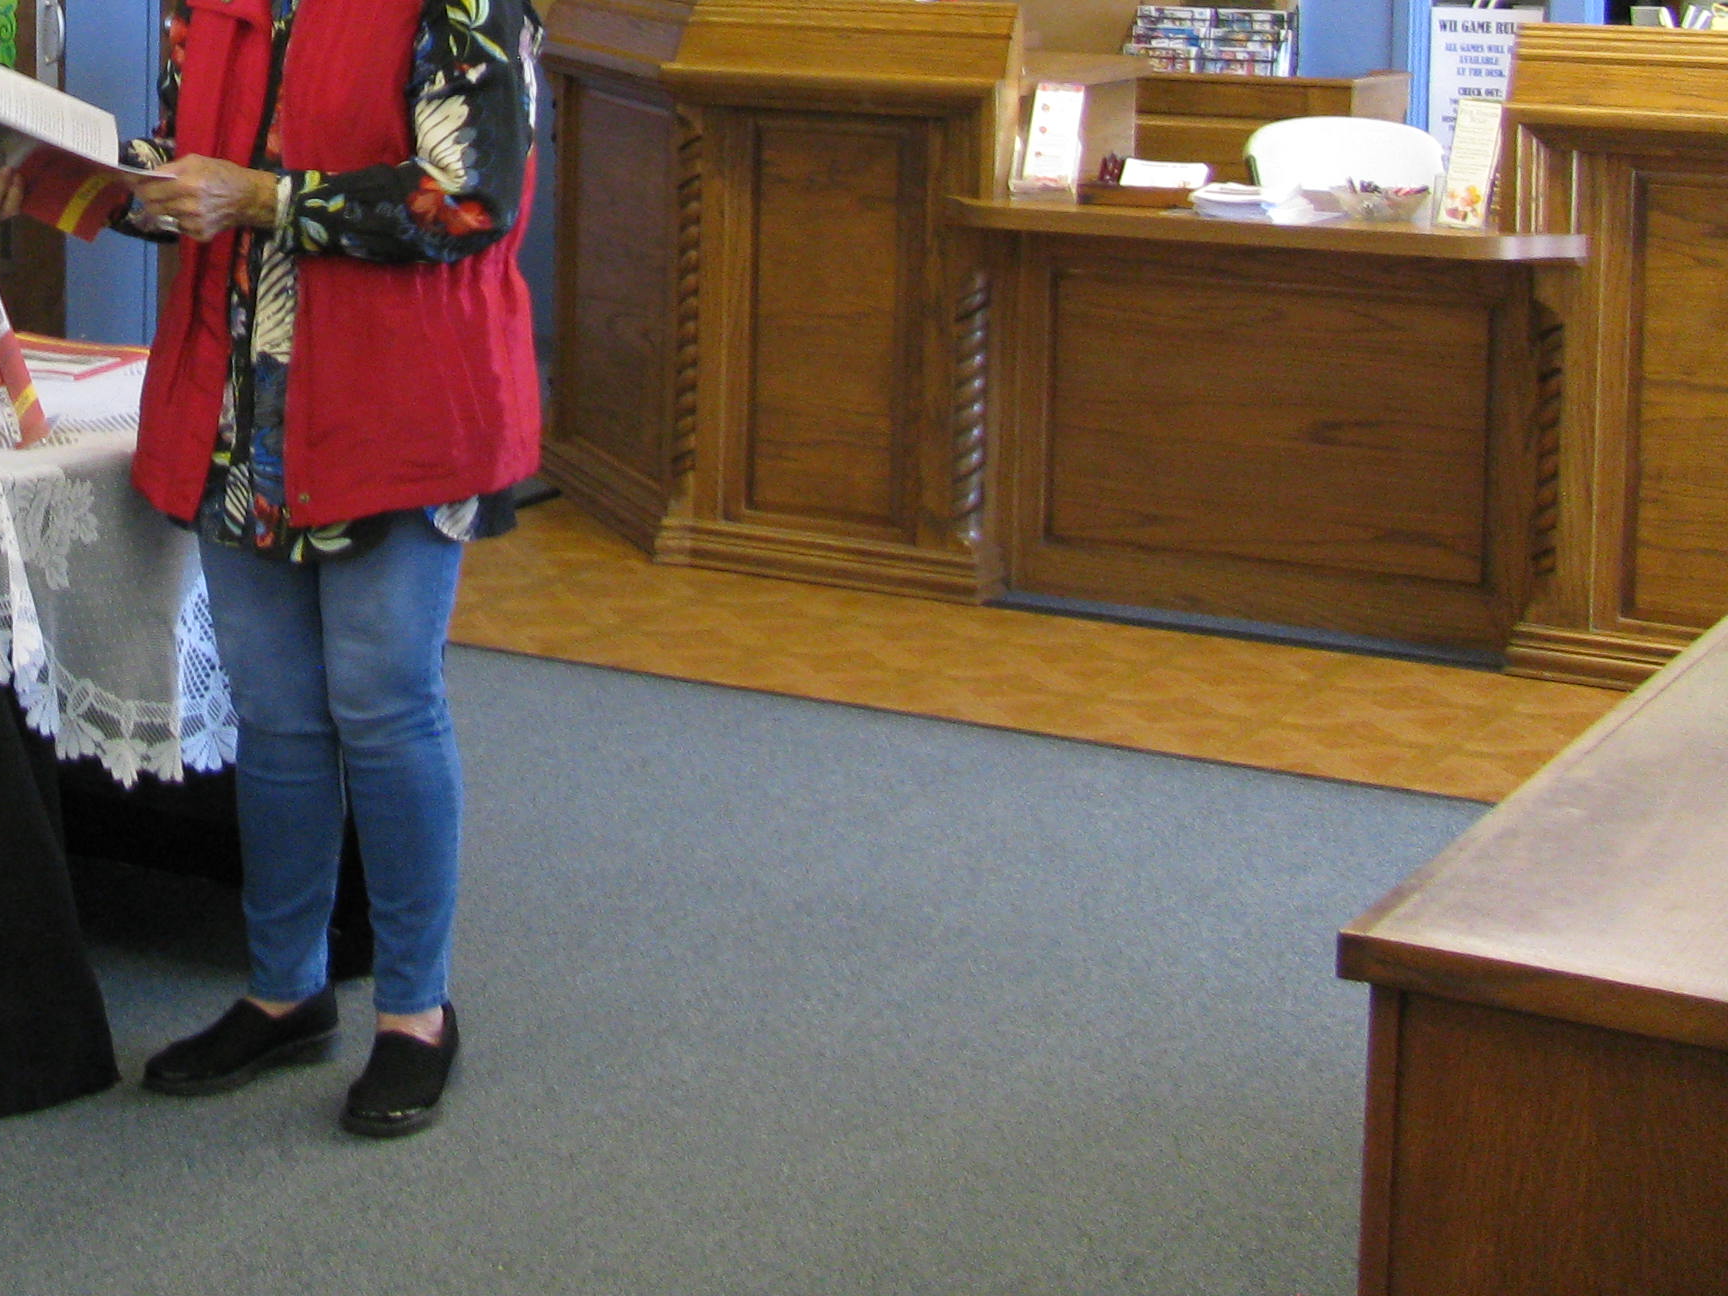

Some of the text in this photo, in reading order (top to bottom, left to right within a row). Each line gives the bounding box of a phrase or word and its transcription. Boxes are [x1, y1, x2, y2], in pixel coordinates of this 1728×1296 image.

[1461, 20, 1492, 34] GAME
[1460, 42, 1485, 54] GAMES
[1458, 86, 1482, 97] CHECK
